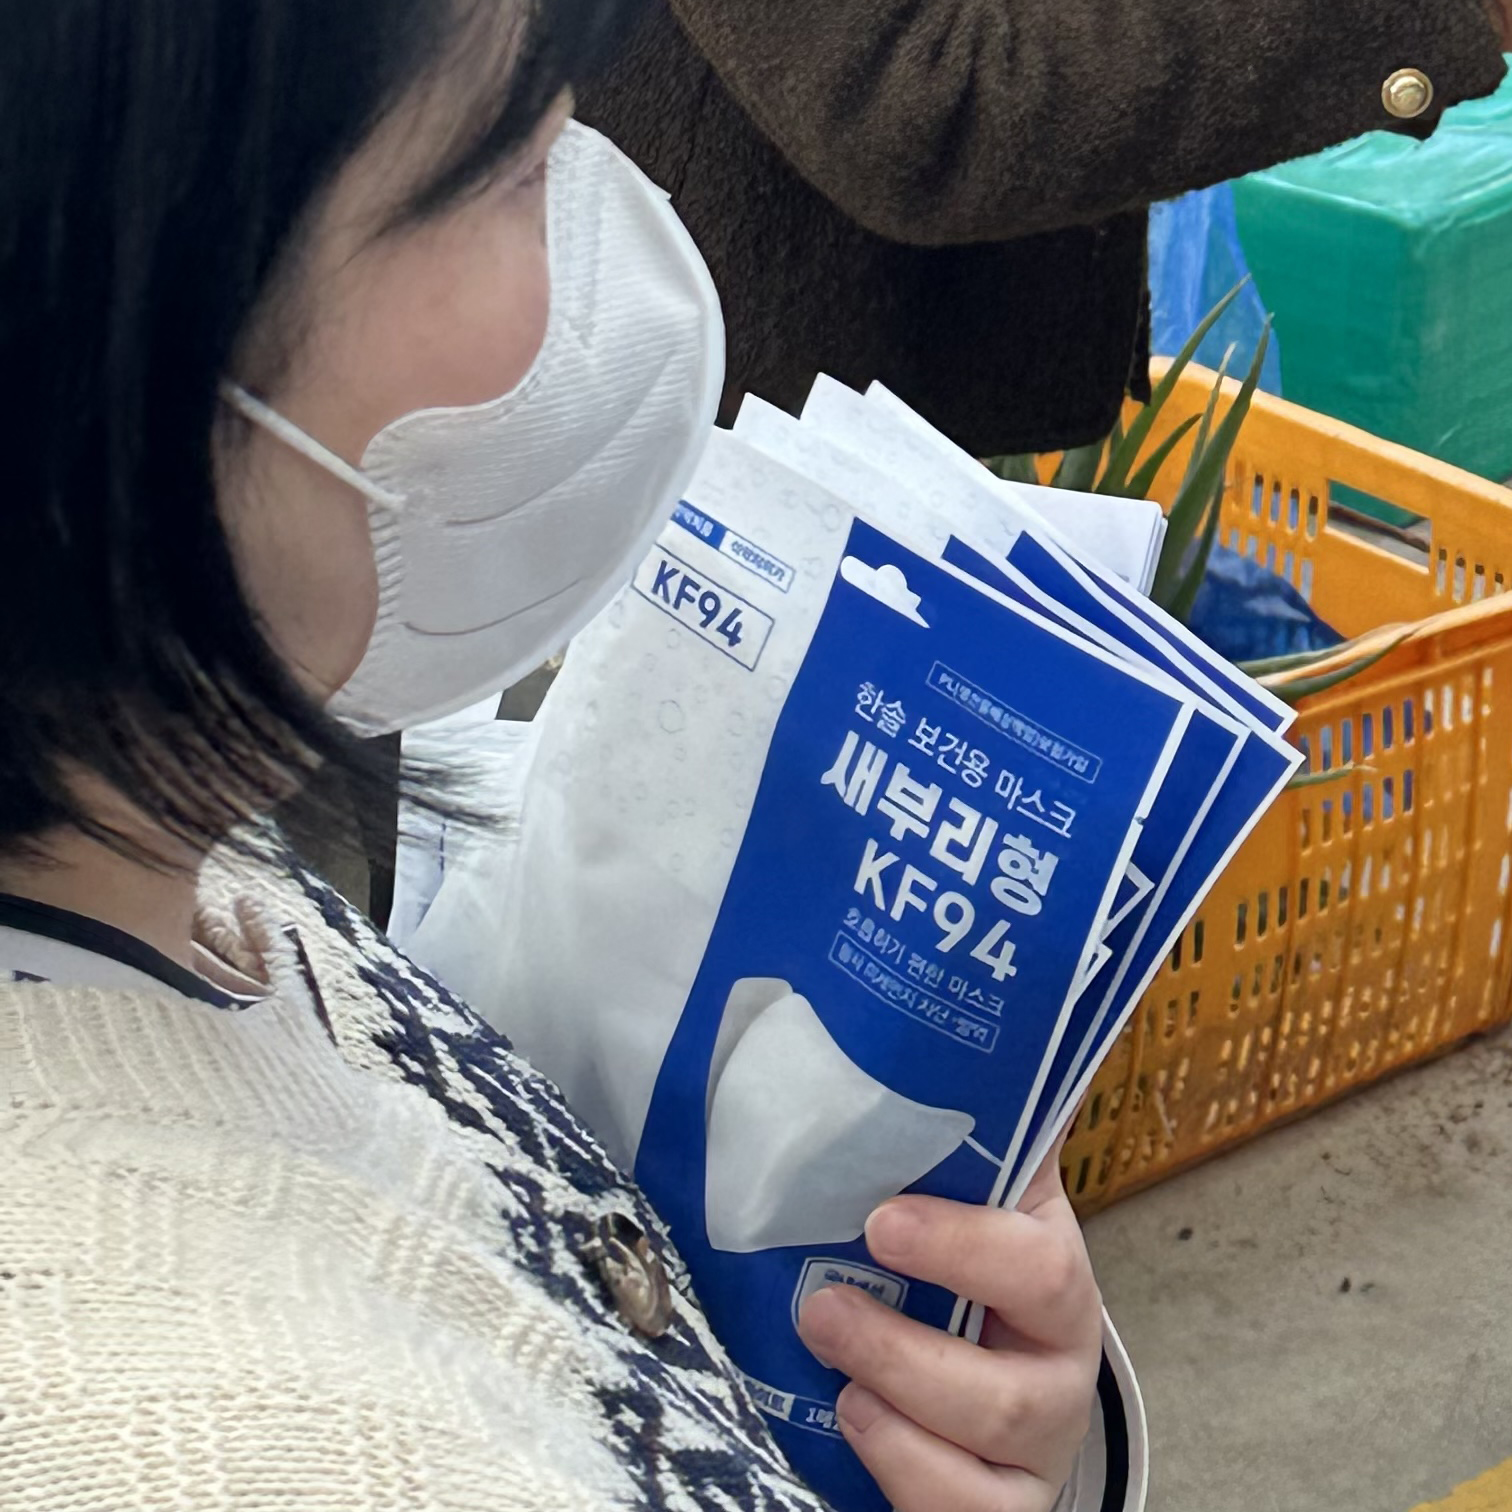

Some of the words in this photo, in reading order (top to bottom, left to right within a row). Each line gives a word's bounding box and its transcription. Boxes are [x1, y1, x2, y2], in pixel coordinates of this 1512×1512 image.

[650, 560, 742, 646] KF94
[821, 731, 1058, 915] 새부리형
[855, 682, 905, 737] 한솔
[908, 718, 989, 787] 보건용
[995, 770, 1075, 837] 마스크
[854, 839, 1016, 981] KF94
[949, 977, 1003, 1016] 마스크
